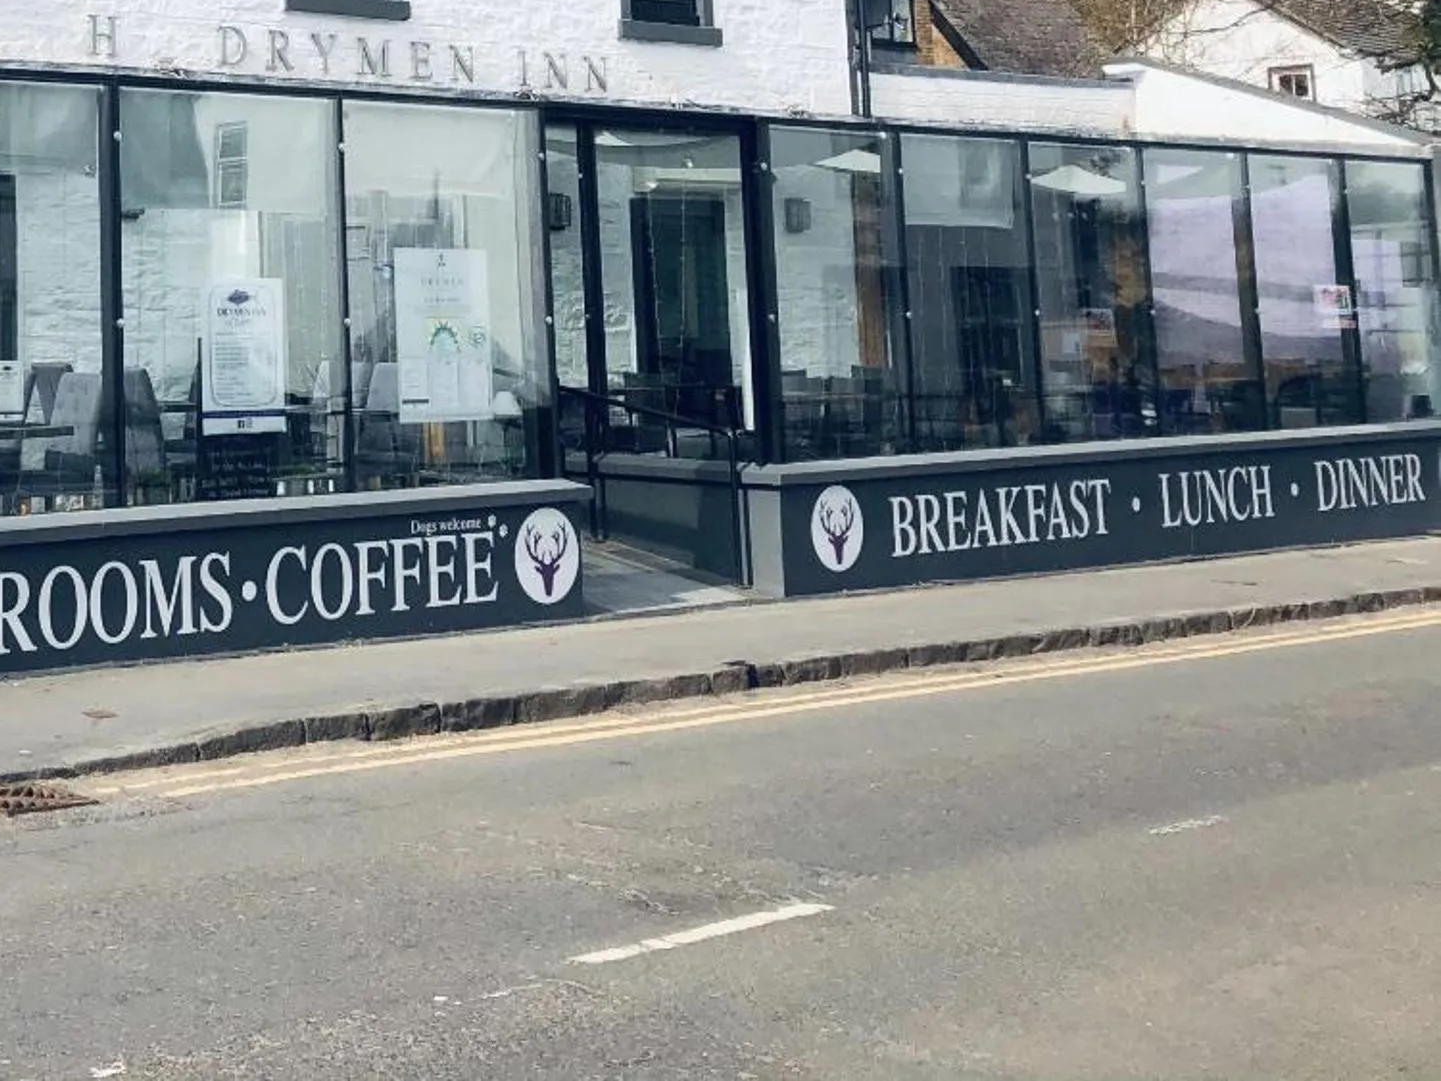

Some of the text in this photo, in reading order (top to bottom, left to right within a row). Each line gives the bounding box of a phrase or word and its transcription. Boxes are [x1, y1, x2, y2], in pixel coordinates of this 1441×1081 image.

[217, 25, 475, 83] DRYMEN
[517, 49, 607, 92] INN
[411, 518, 481, 536] Dogs welcome
[890, 453, 1427, 557] BREAKFAST LUNCH DINNER
[266, 532, 501, 626] COFFEE
